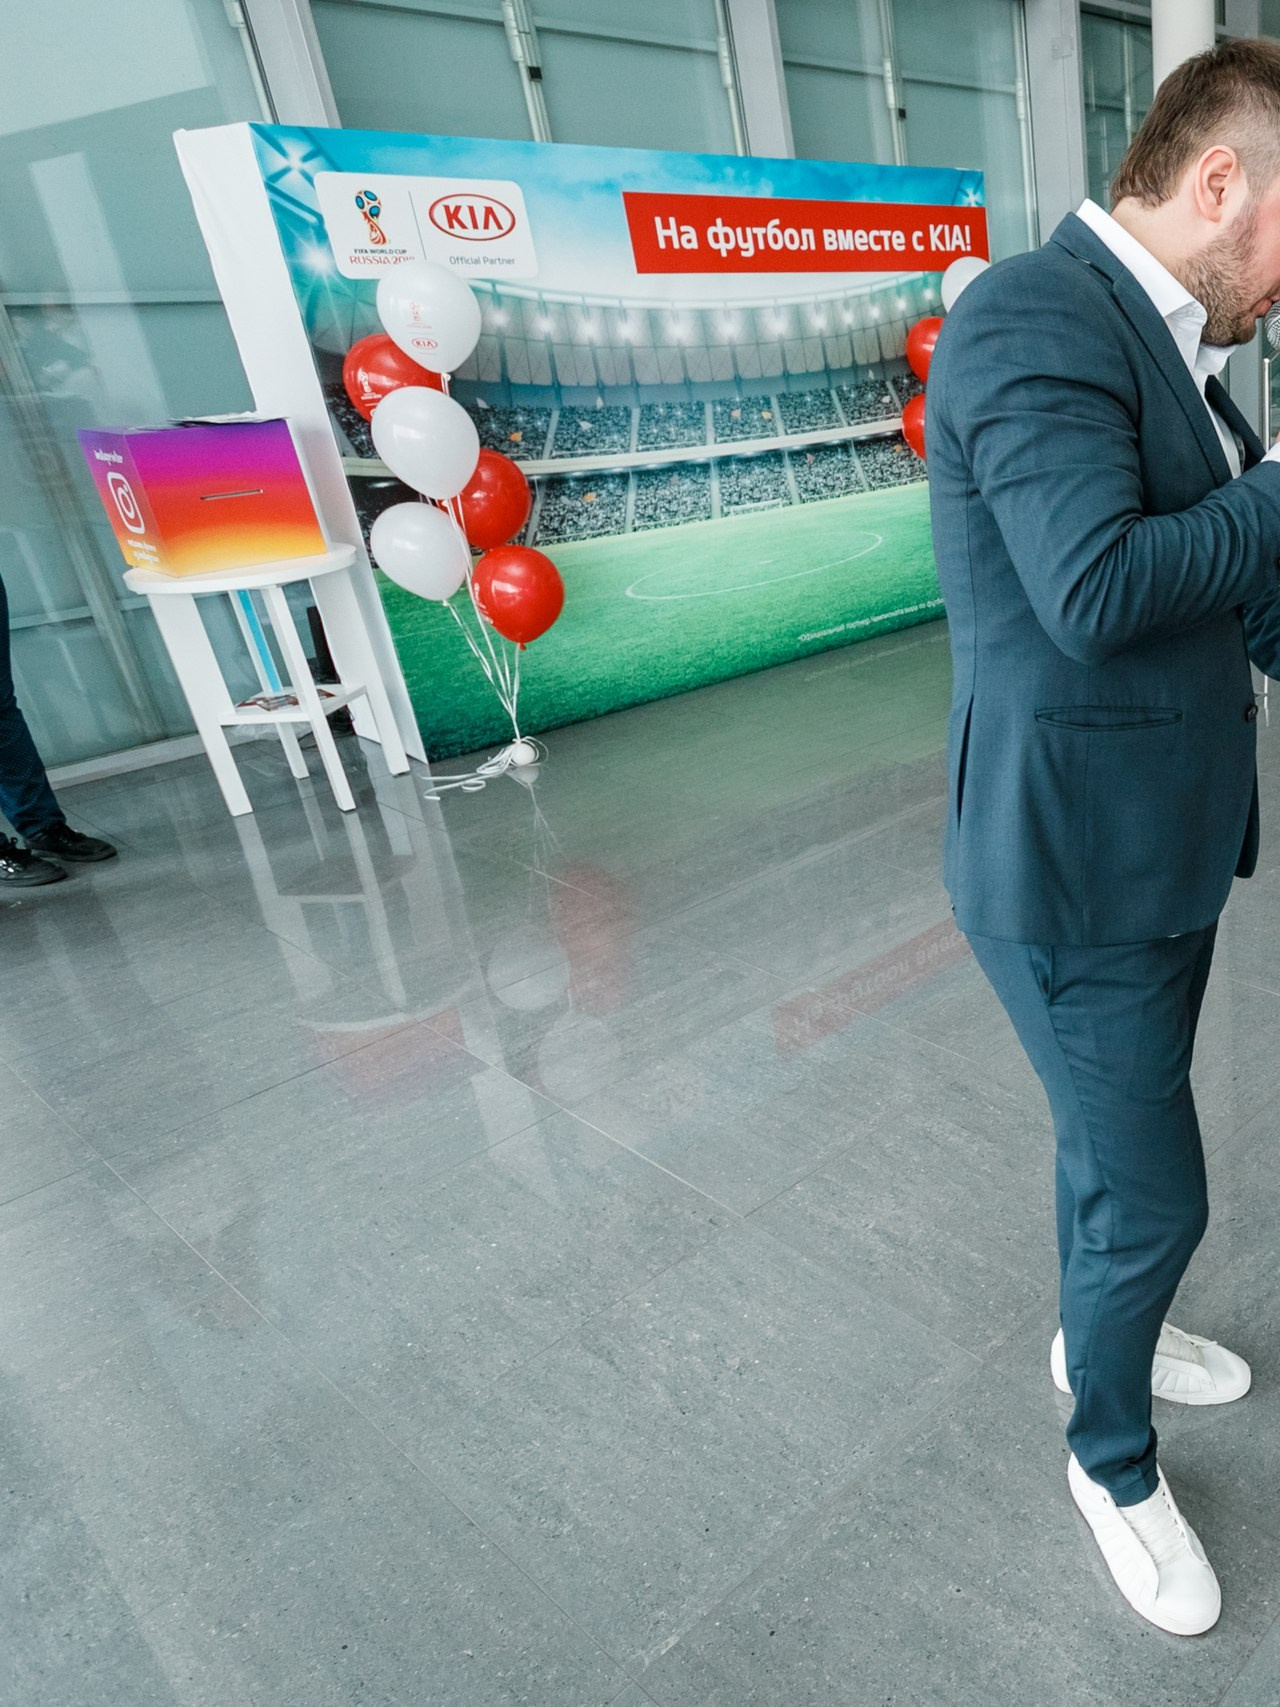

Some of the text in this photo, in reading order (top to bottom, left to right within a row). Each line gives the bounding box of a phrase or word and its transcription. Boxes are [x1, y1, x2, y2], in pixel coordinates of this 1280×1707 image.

[443, 203, 504, 231] KIA
[654, 216, 972, 257] На футбол вместе с KIA!
[349, 255, 390, 265] RUSSIA
[449, 255, 515, 266] Official Partner
